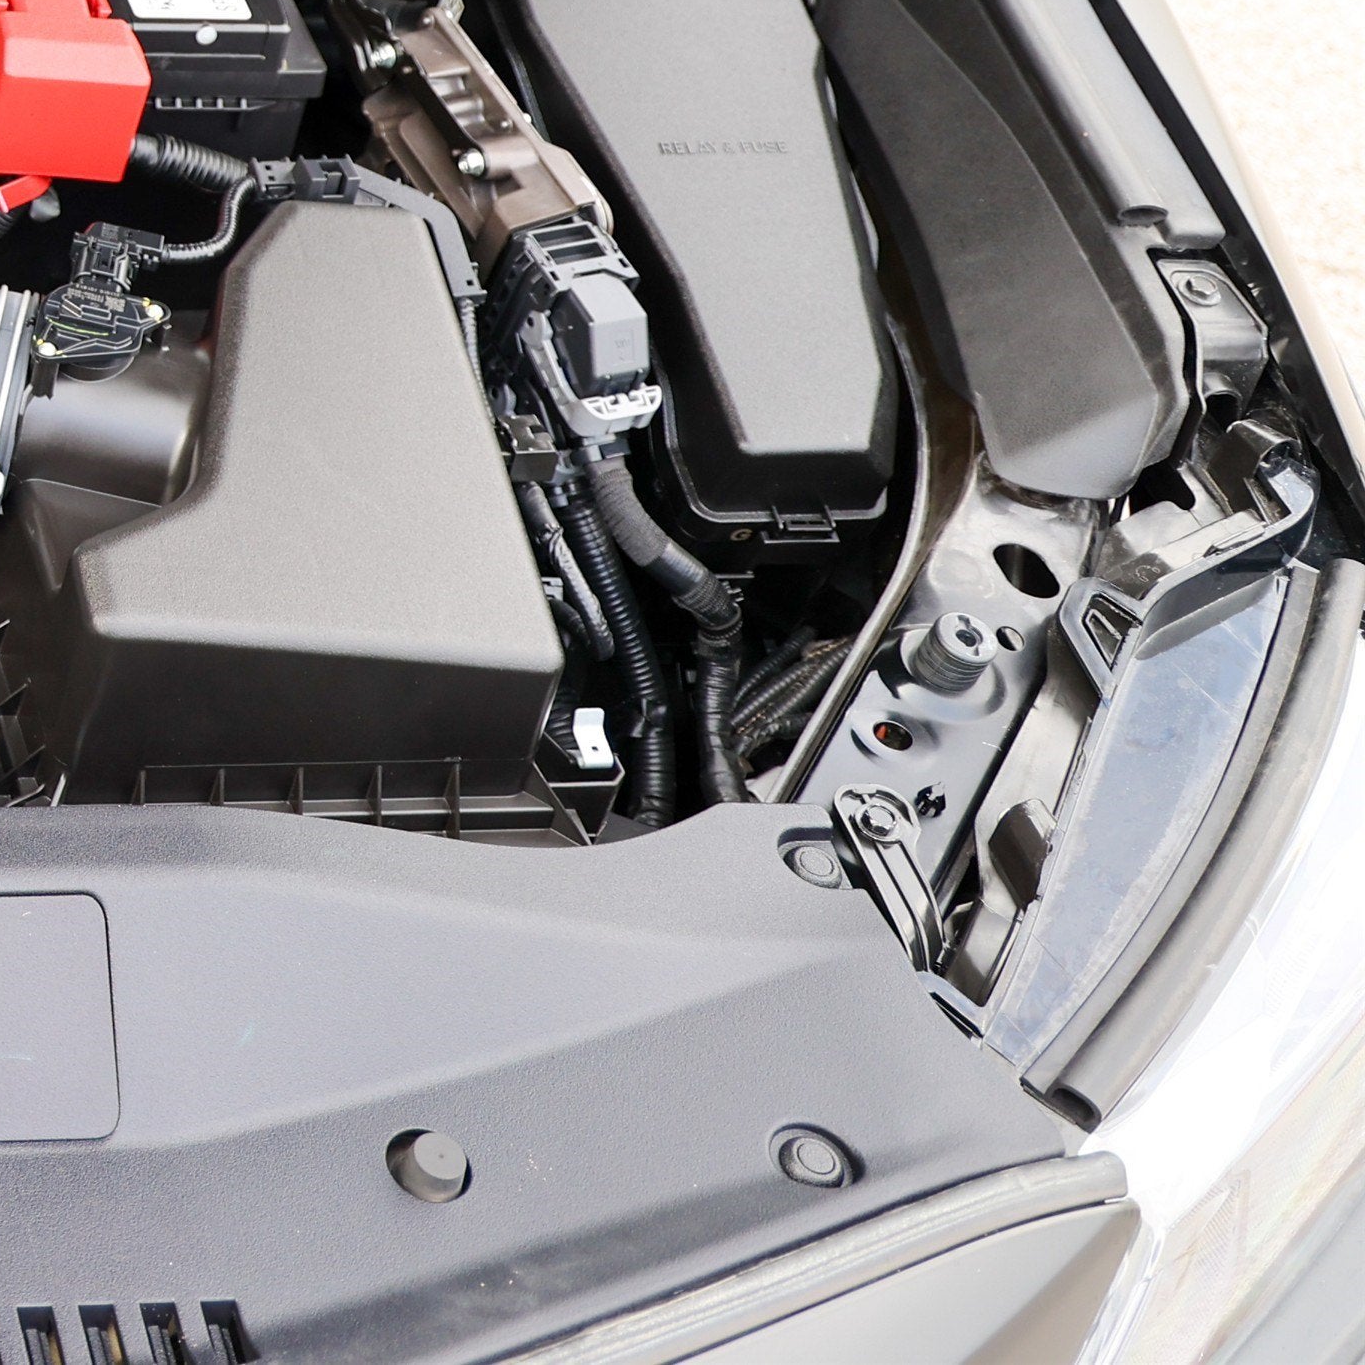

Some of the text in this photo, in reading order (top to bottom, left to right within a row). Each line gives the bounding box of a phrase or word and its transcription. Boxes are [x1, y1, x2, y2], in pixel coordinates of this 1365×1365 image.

[659, 141, 789, 156] RELAY & FUSE
